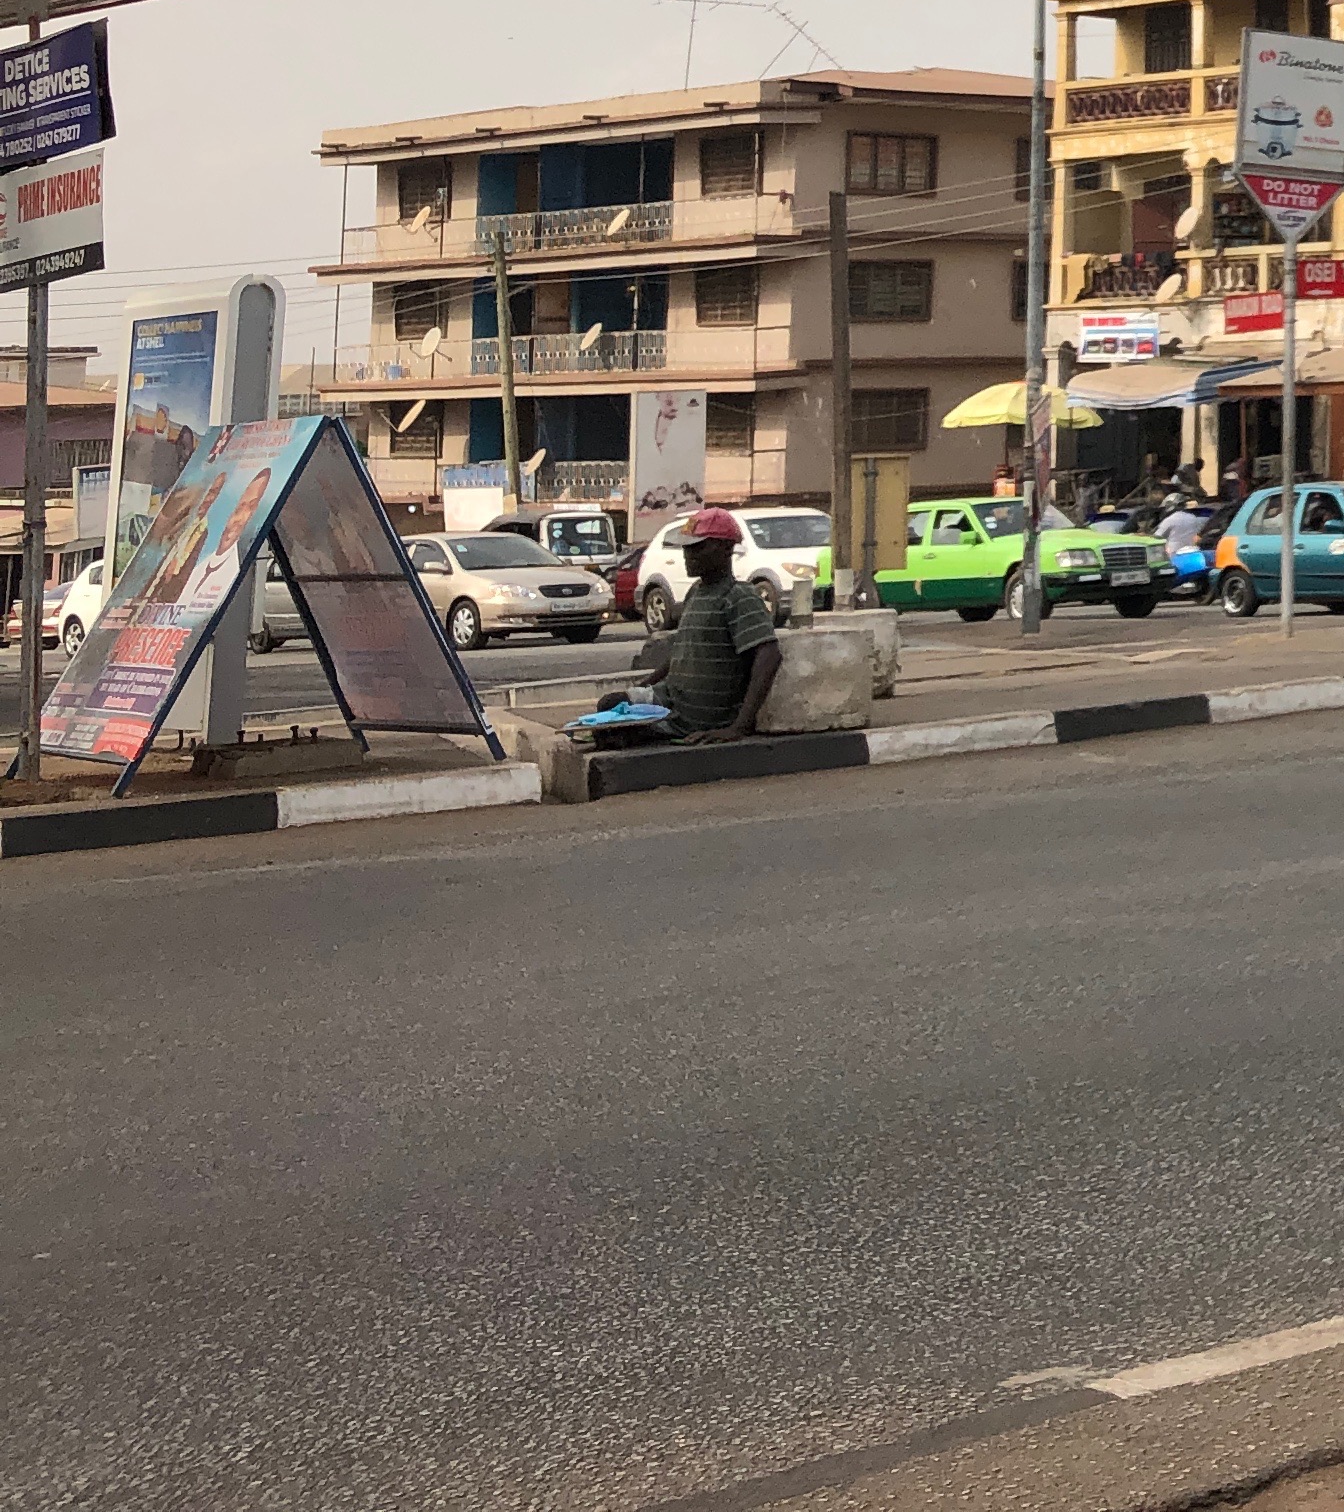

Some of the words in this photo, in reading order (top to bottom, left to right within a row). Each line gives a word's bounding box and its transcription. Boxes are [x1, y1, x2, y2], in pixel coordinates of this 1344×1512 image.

[4, 48, 50, 83] DETICE
[0, 83, 27, 110] ING
[28, 64, 91, 103] SERVICES
[17, 178, 46, 224] PRIME
[46, 164, 101, 217] INSURANCE
[1262, 179, 1285, 191] DO
[1288, 182, 1321, 196] NOT
[1268, 192, 1318, 207] LITTER
[1304, 263, 1336, 283] OSEI
